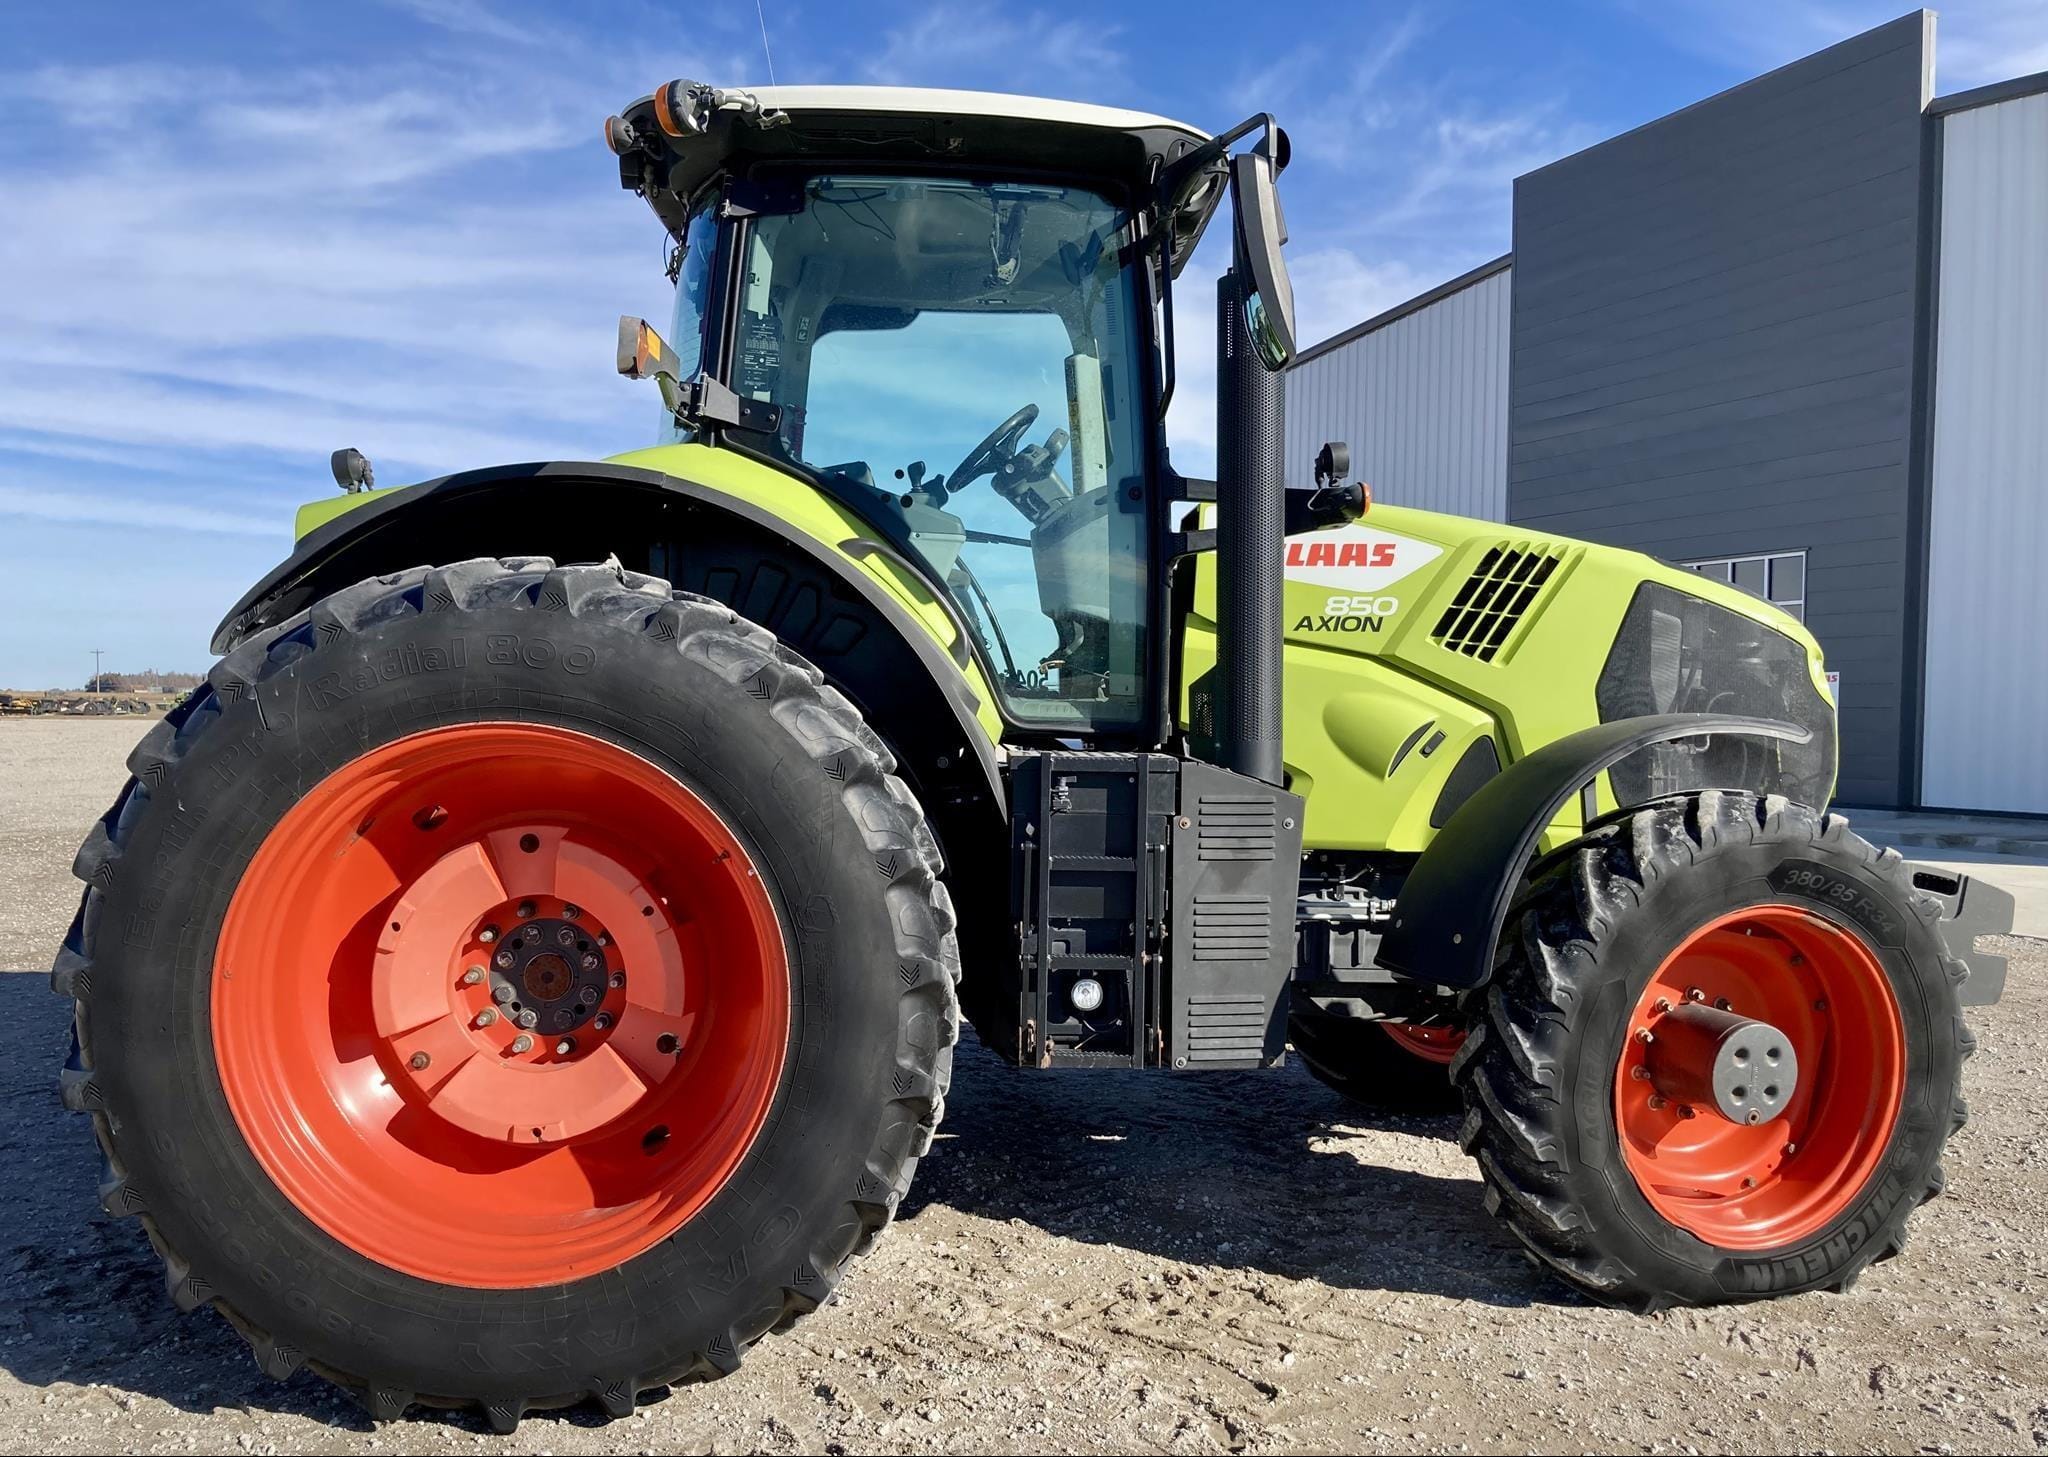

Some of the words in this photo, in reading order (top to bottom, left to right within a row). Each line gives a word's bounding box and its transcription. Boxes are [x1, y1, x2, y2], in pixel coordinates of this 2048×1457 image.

[1284, 543, 1396, 567] LAAS
[1325, 596, 1399, 617] 850
[1293, 615, 1384, 633] AXION
[304, 638, 468, 711] Radial
[486, 634, 597, 676] 800
[1783, 869, 1859, 902] 380/85
[1742, 1171, 1907, 1292] MICHELIN
